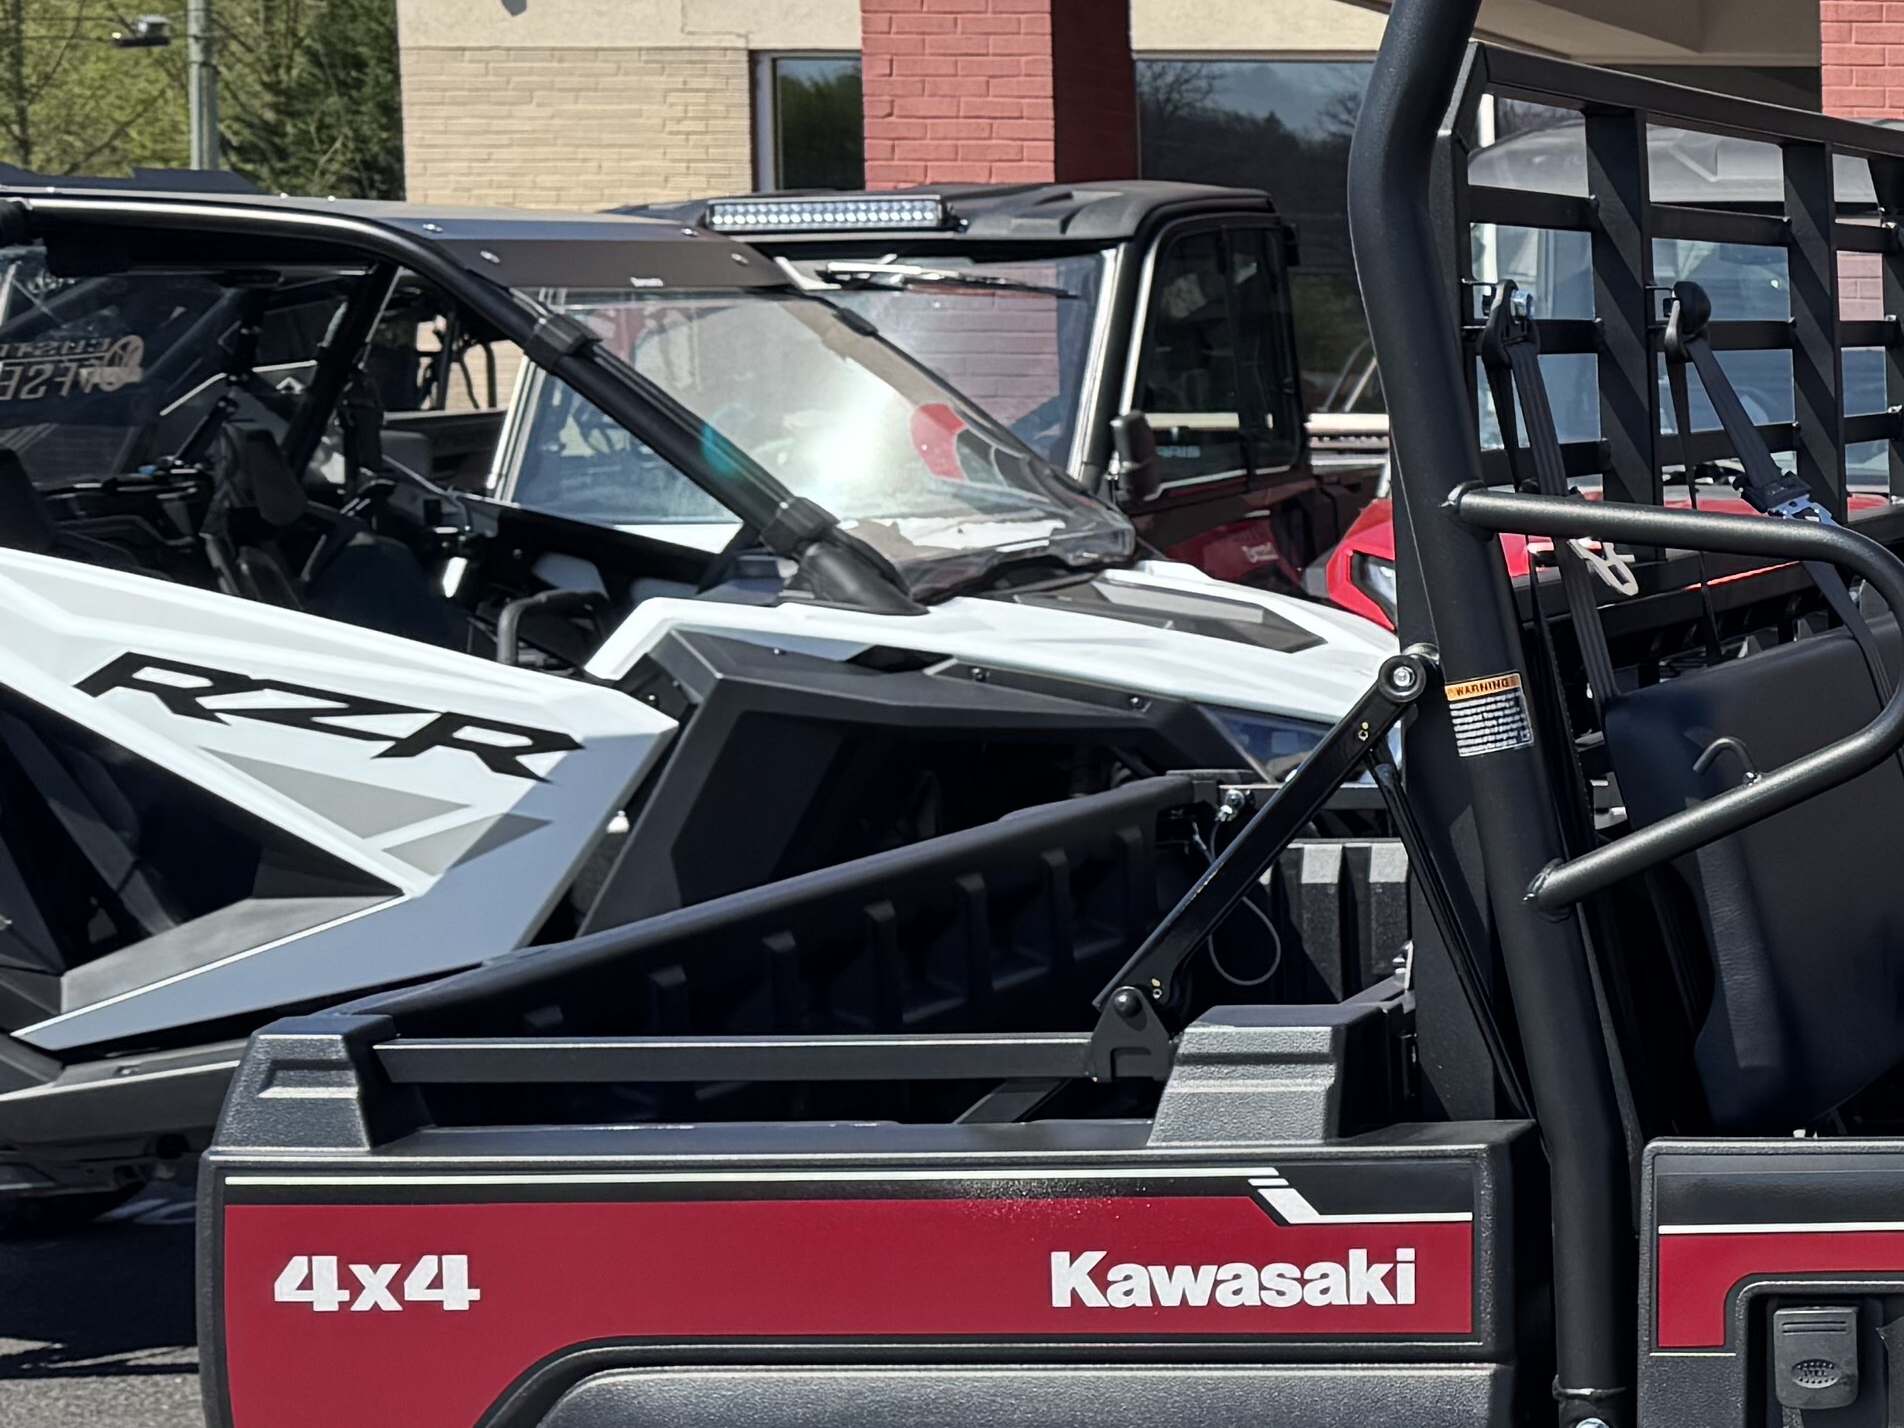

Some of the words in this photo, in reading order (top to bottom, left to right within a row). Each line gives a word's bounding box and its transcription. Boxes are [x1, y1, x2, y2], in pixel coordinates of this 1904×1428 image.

[1456, 678, 1510, 697] WARNING
[73, 651, 588, 784] RZR
[274, 1254, 481, 1312] 4x4
[1050, 1249, 1416, 1309] Kawasaki
